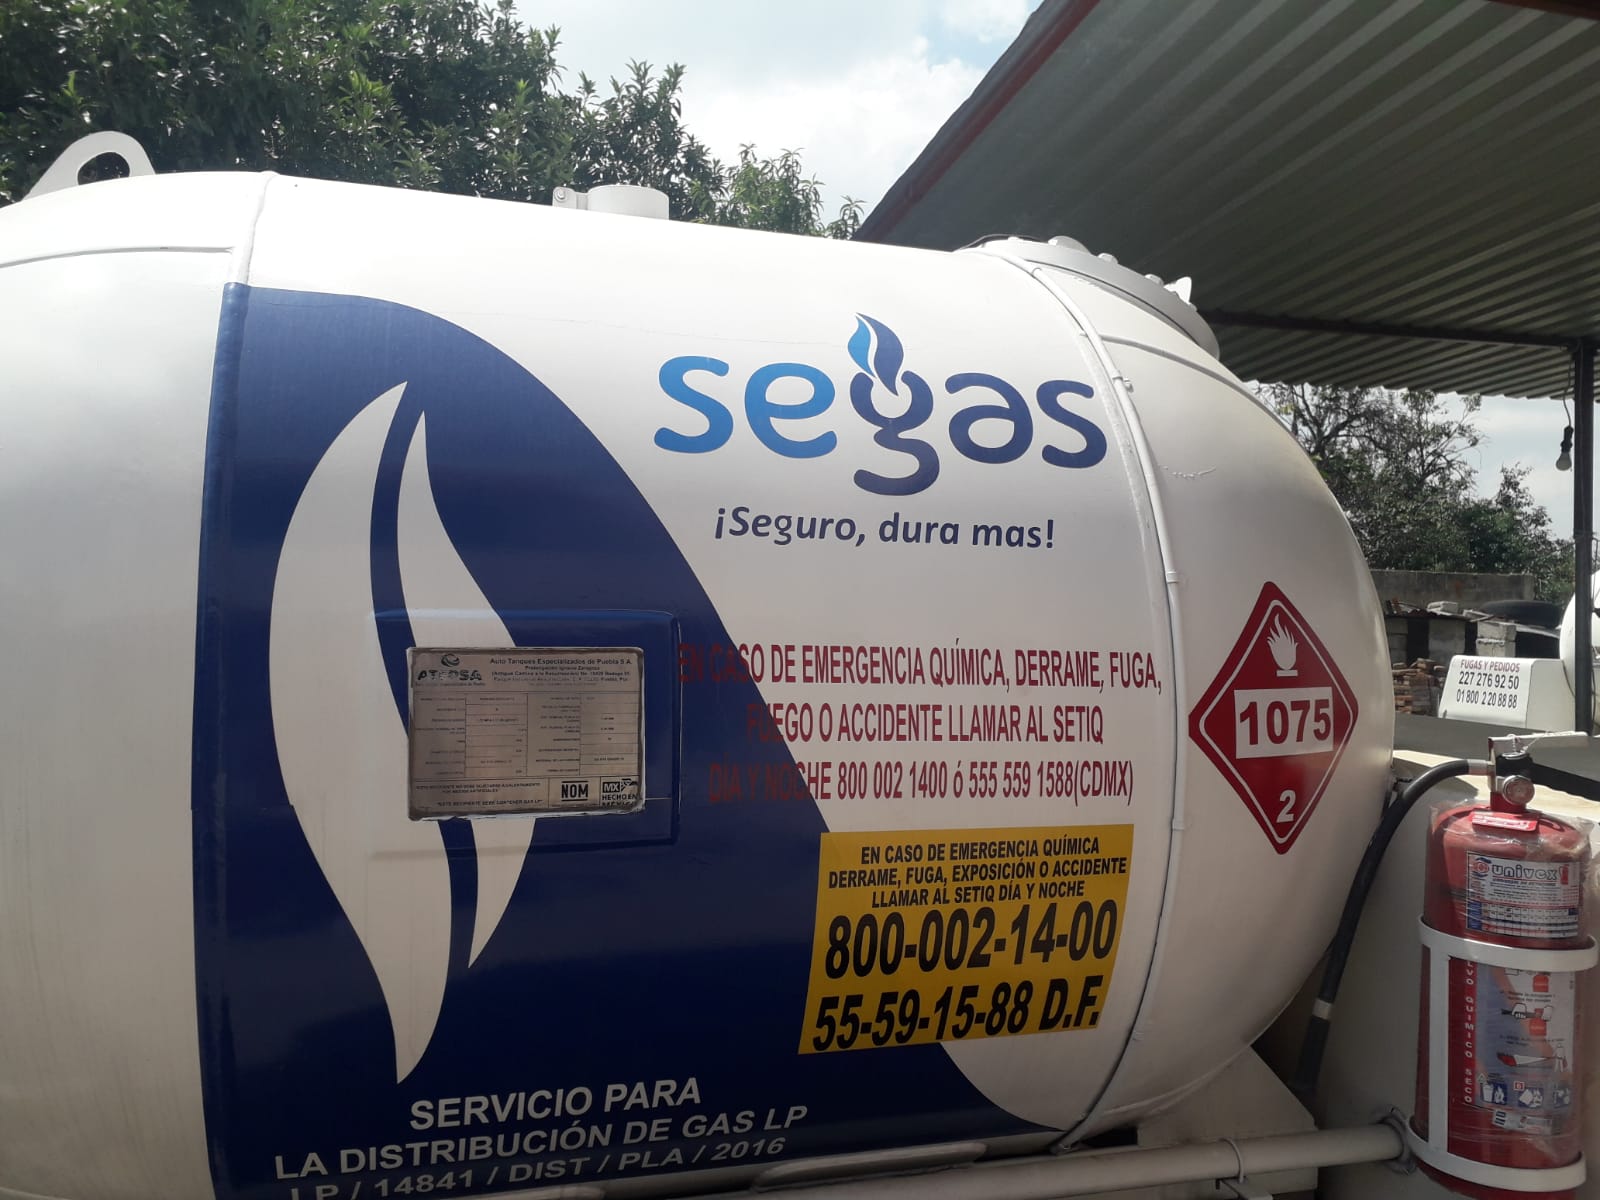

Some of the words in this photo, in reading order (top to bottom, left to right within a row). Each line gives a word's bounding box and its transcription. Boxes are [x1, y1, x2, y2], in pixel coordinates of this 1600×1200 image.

[654, 355, 1107, 496] segas
[715, 506, 866, 548] ¡Seguro,
[879, 512, 960, 545] dura
[972, 519, 1055, 549] mas!
[677, 643, 704, 684] EN
[709, 643, 765, 684] CASO
[771, 644, 797, 683] DE
[802, 645, 926, 685] EMERGENCIA
[929, 638, 1010, 693] QUÍMICA,
[1015, 650, 1105, 694] DERRAME,
[1110, 652, 1162, 695] FUGA,
[1458, 671, 1475, 685] 227
[1476, 672, 1493, 687] 276
[1494, 674, 1506, 688] 92
[1508, 675, 1520, 690] 50
[1461, 659, 1483, 670] FUGAS
[1484, 661, 1489, 670] Y
[1490, 661, 1520, 673] PEDIDOS
[1456, 688, 1465, 703] 01
[1466, 689, 1480, 704] 800
[1481, 691, 1487, 705] 2
[1488, 692, 1497, 706] 20
[1508, 694, 1518, 709] 88
[747, 703, 814, 742] FUEGO
[819, 703, 833, 742] O
[838, 703, 943, 742] ACCIDENTE
[949, 704, 1022, 742] LLAMAR
[1026, 705, 1049, 742] AL
[1053, 705, 1104, 744] SETIQ
[1239, 698, 1331, 746] 1075
[561, 784, 589, 799] NOM
[603, 783, 619, 793] MX
[748, 763, 760, 800] Y
[765, 761, 832, 800] NOCHE
[838, 761, 868, 800] 800
[873, 761, 903, 799] 002
[909, 761, 948, 799] 1400
[953, 760, 963, 799] ó
[969, 761, 998, 798] 555
[1002, 761, 1031, 798] 559
[1276, 789, 1296, 823] 2
[861, 846, 880, 865] EN
[884, 844, 923, 864] CASO
[927, 843, 946, 862] DE
[949, 840, 1039, 861] EMERGENCIA
[1043, 834, 1099, 857] QUÍMICA
[828, 868, 902, 889] DERRAME,
[906, 866, 947, 886] FUGA,
[952, 858, 1036, 882] EXPOSICIÓN
[1039, 860, 1049, 878] O
[1052, 857, 1127, 877] ACCIDENTE
[872, 888, 928, 908] LLAMAR
[932, 888, 950, 905] AL
[954, 884, 995, 904] SETIQ
[998, 880, 1021, 901] DÍA
[1026, 883, 1035, 899] Y
[1038, 880, 1085, 899] NOCHE
[825, 899, 1118, 979] 800-002-14-00
[812, 980, 1034, 1052] 55-59-15-88
[1038, 975, 1104, 1031] D.F.
[409, 1086, 593, 1130] SERVICIO
[603, 1077, 701, 1113] PARA
[275, 1152, 328, 1179] LA
[340, 1120, 612, 1174] DISTRIBUCIÓN
[623, 1117, 673, 1144] DE
[682, 1110, 755, 1139] GAS
[764, 1105, 808, 1131] LP
[374, 1169, 474, 1197] 14841
[508, 1156, 591, 1183] DIST
[618, 1148, 684, 1171] PLA
[711, 1137, 786, 1161] 2016
